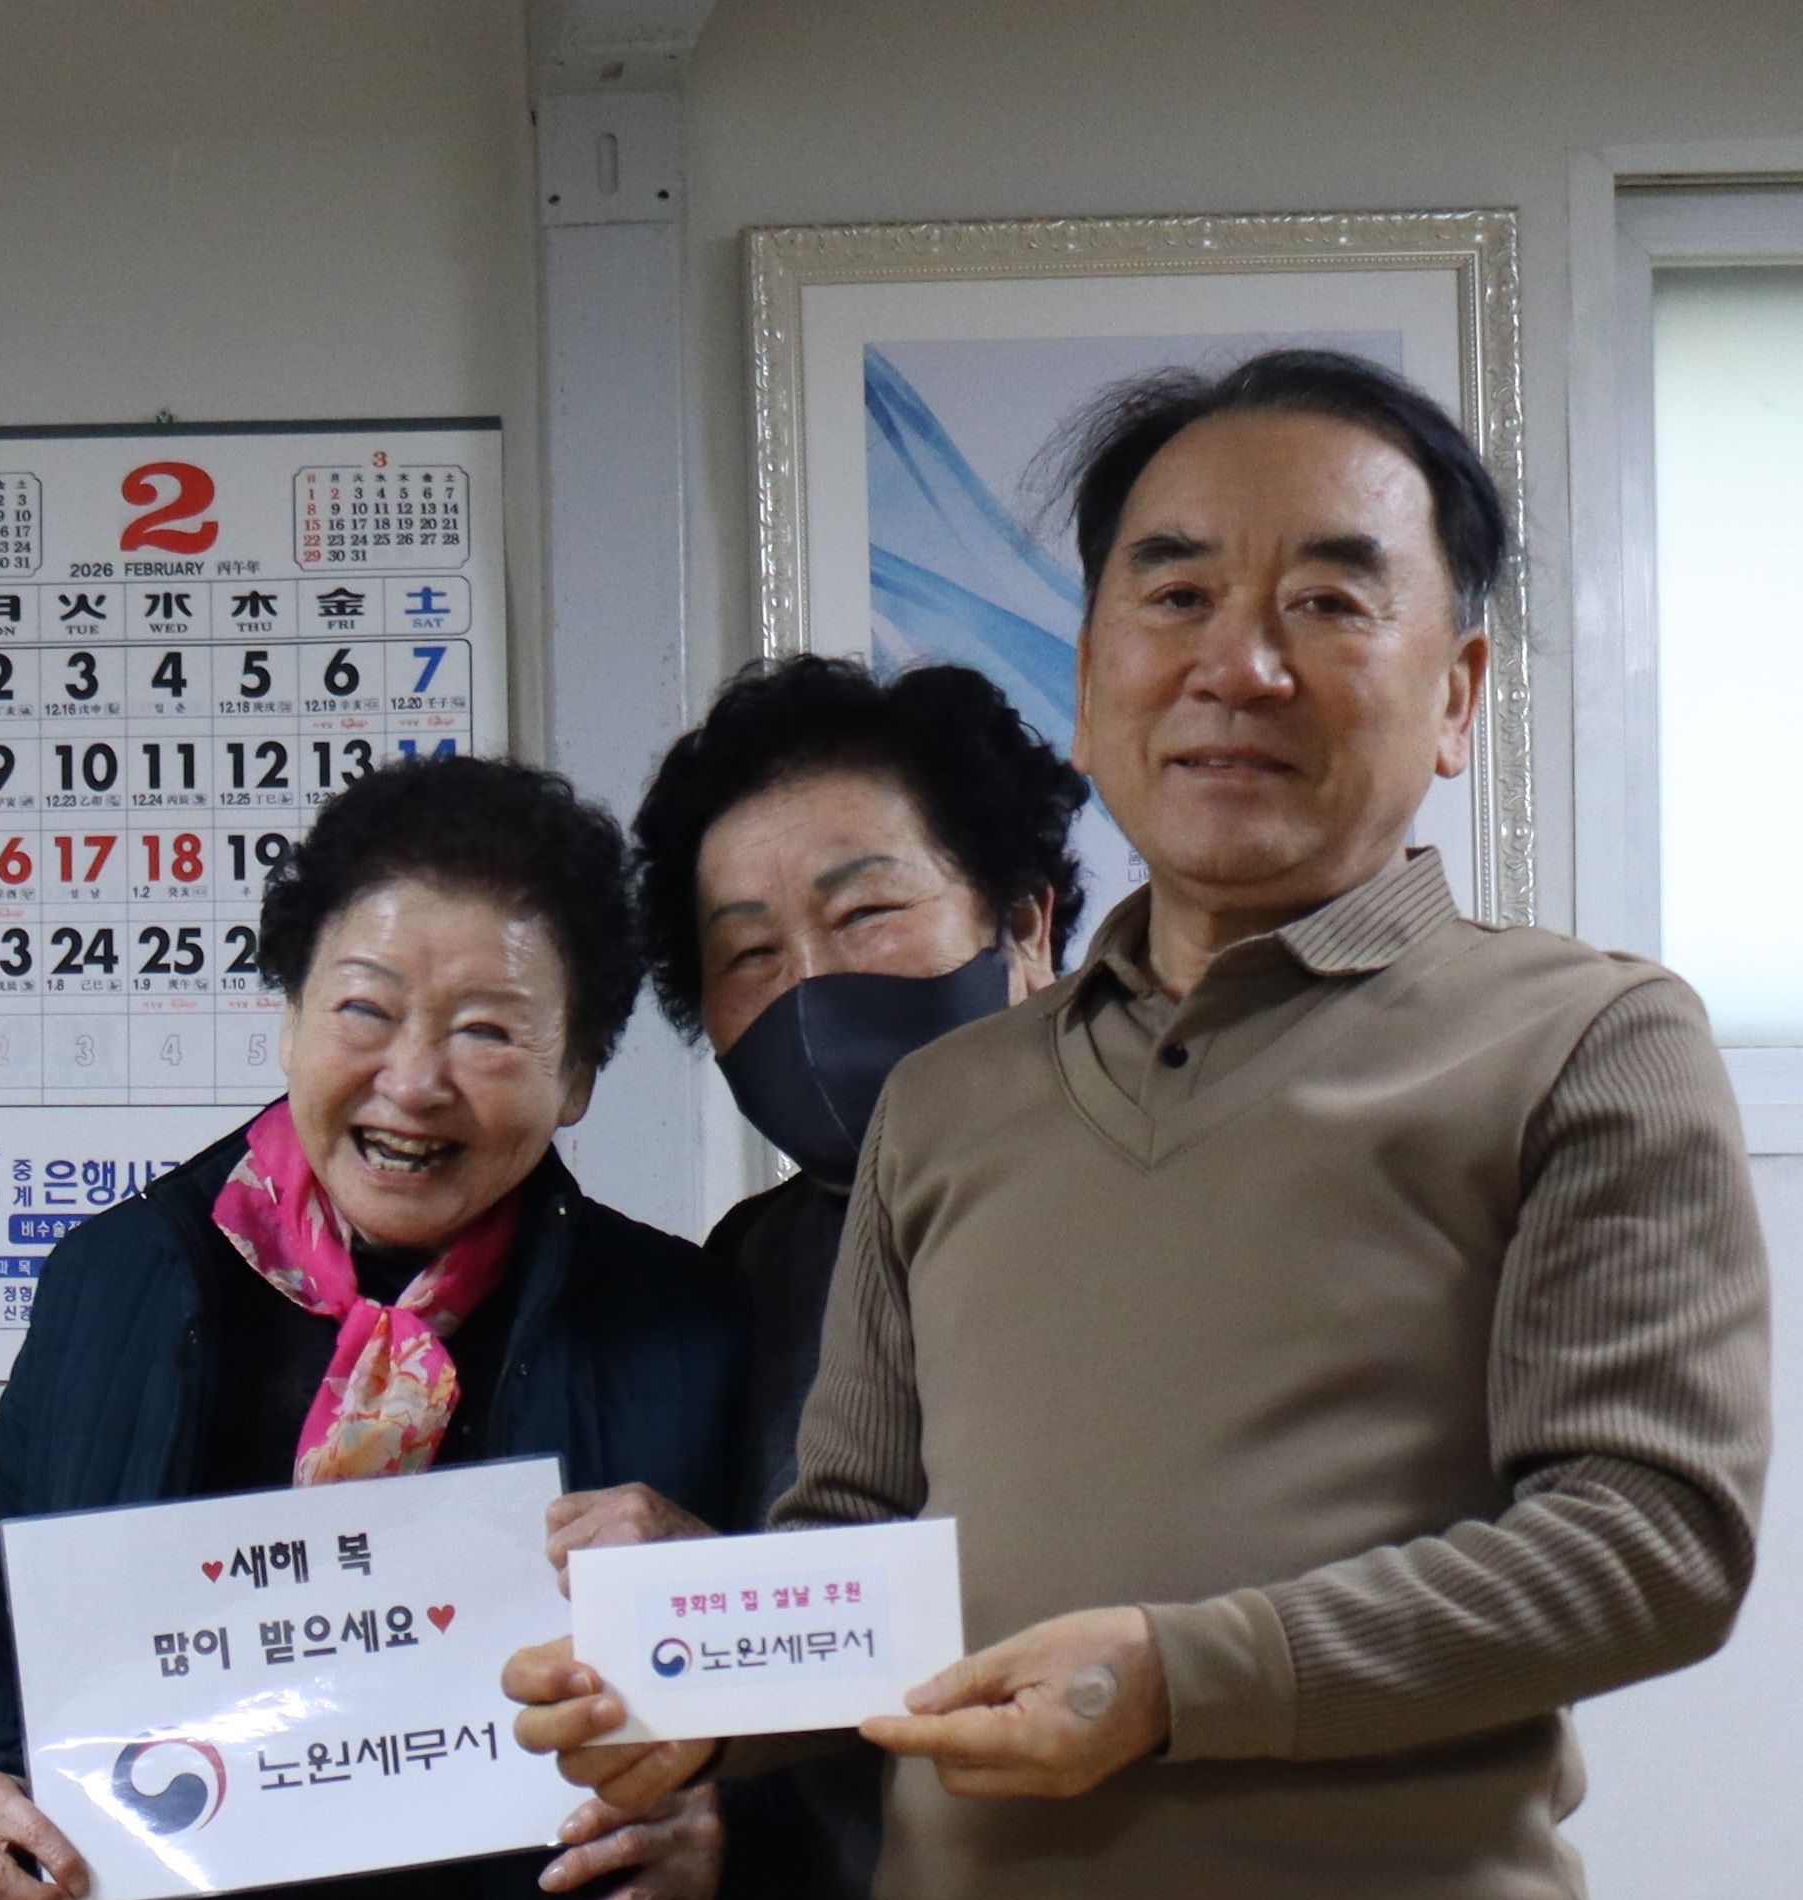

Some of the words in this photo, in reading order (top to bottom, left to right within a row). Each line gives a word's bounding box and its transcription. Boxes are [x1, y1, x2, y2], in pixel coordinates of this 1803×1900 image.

[373, 451, 387, 467] 3
[18, 494, 26, 506] 3
[309, 489, 314, 500] 1
[331, 488, 339, 500] 2
[354, 487, 363, 499] 3
[377, 488, 385, 498] 4
[400, 487, 408, 499] 5
[423, 487, 432, 499] 6
[445, 487, 454, 499] 7
[16, 510, 31, 522] 10
[120, 462, 218, 554] 2
[307, 503, 316, 515] 8
[331, 503, 340, 515] 9
[352, 503, 368, 515] 10
[375, 503, 389, 514] 11
[397, 503, 412, 514] 12
[421, 503, 436, 514] 13
[443, 503, 458, 514] 14
[15, 525, 31, 537] 17
[305, 519, 320, 531] 15
[329, 519, 345, 530] 16
[352, 518, 367, 530] 17
[375, 518, 390, 530] 18
[397, 518, 413, 529] 19
[420, 518, 437, 529] 20
[442, 518, 457, 530] 21
[14, 541, 30, 553] 24
[304, 535, 320, 547] 22
[328, 535, 344, 546] 23
[351, 534, 367, 545] 24
[374, 534, 390, 545] 25
[397, 533, 413, 545] 26
[420, 533, 437, 545] 27
[443, 533, 459, 545] 28
[14, 557, 30, 569] 31
[304, 550, 321, 562] 29
[328, 550, 345, 561] 30
[351, 550, 366, 561] 31
[70, 563, 113, 577] 2026
[125, 562, 204, 576] FEBRUARY
[58, 594, 106, 621] 火
[145, 592, 192, 619] 水
[232, 590, 277, 618] 木
[317, 587, 365, 617] 金
[405, 586, 450, 614] 土
[66, 625, 99, 635] TUE
[150, 623, 188, 633] WED
[236, 622, 272, 632] THU
[328, 620, 354, 630] FRI
[413, 618, 443, 628] SAT
[65, 652, 98, 700] 3
[152, 652, 187, 697] 4
[241, 651, 271, 698] 5
[324, 648, 359, 696] 6
[413, 646, 447, 693] 7
[45, 703, 76, 716] 12.16
[219, 701, 250, 713] 12.18
[305, 699, 336, 712] 12.19
[391, 697, 422, 710] 12.20
[55, 743, 118, 792] 10
[143, 743, 195, 789] 11
[227, 741, 288, 788] 12
[313, 739, 374, 788] 13
[46, 795, 76, 807] 12.23
[132, 794, 162, 806] 12.24
[220, 793, 250, 805] 12.25
[55, 836, 117, 882] 17
[142, 833, 203, 882] 18
[228, 833, 290, 881] 19
[133, 886, 150, 898] 1.2
[51, 927, 118, 974] 24
[138, 926, 204, 975] 25
[47, 979, 64, 991] 1.8
[133, 978, 150, 990] 1.9
[221, 978, 245, 990] 1.10
[76, 1035, 95, 1066] 3
[161, 1035, 182, 1065] 4
[248, 1035, 267, 1065] 5
[44, 1159, 187, 1205] 은행사
[230, 1540, 309, 1588] 새해
[337, 1533, 372, 1577] 복
[671, 1593, 727, 1617] 평화의
[741, 1590, 758, 1611] 집
[772, 1585, 810, 1609] 설날
[824, 1581, 862, 1603] 후원
[153, 1627, 231, 1677] 많이
[259, 1605, 419, 1665] 받으세요
[701, 1629, 875, 1671] 노원세무서
[257, 1722, 498, 1791] 노원세무서
